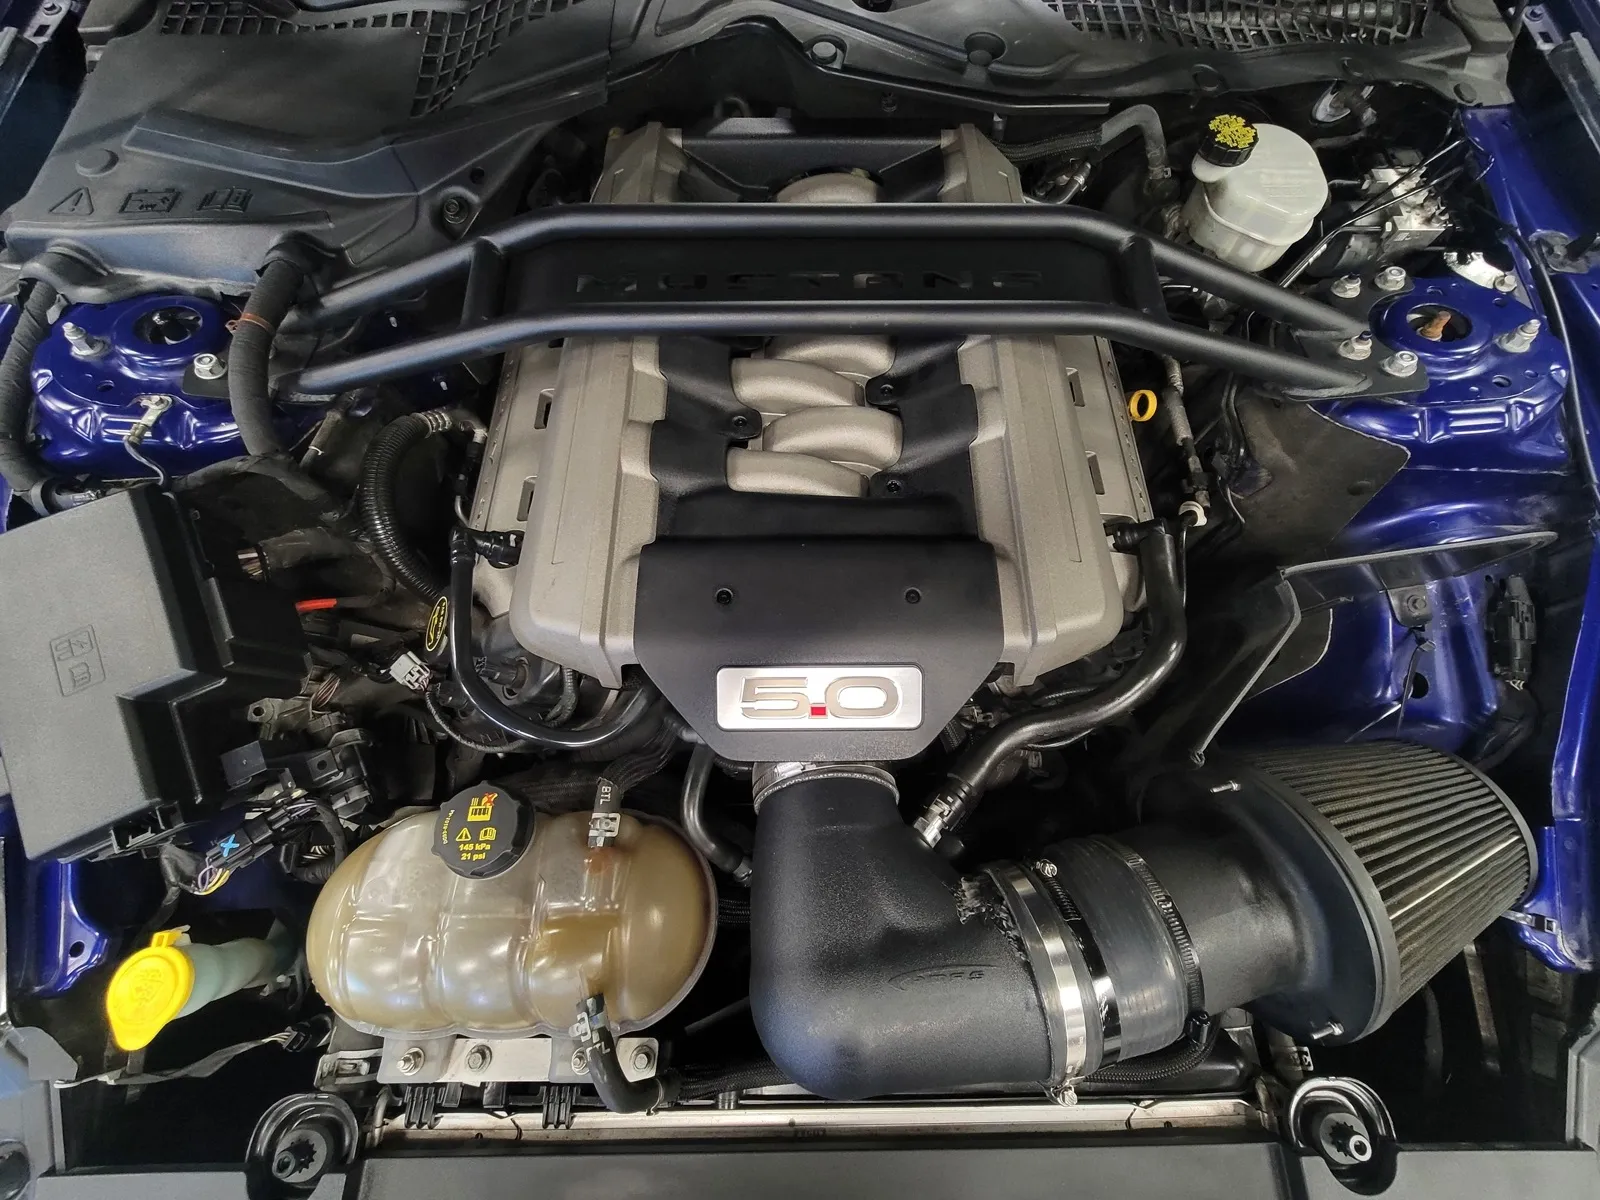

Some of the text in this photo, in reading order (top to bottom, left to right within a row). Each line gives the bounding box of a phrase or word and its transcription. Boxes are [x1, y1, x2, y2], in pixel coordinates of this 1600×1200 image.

[576, 272, 1043, 292] MUSTANG
[740, 676, 899, 719] 5.0
[600, 785, 612, 805] BTL
[459, 843, 491, 851] 145 kPa
[461, 852, 486, 861] 21 psi
